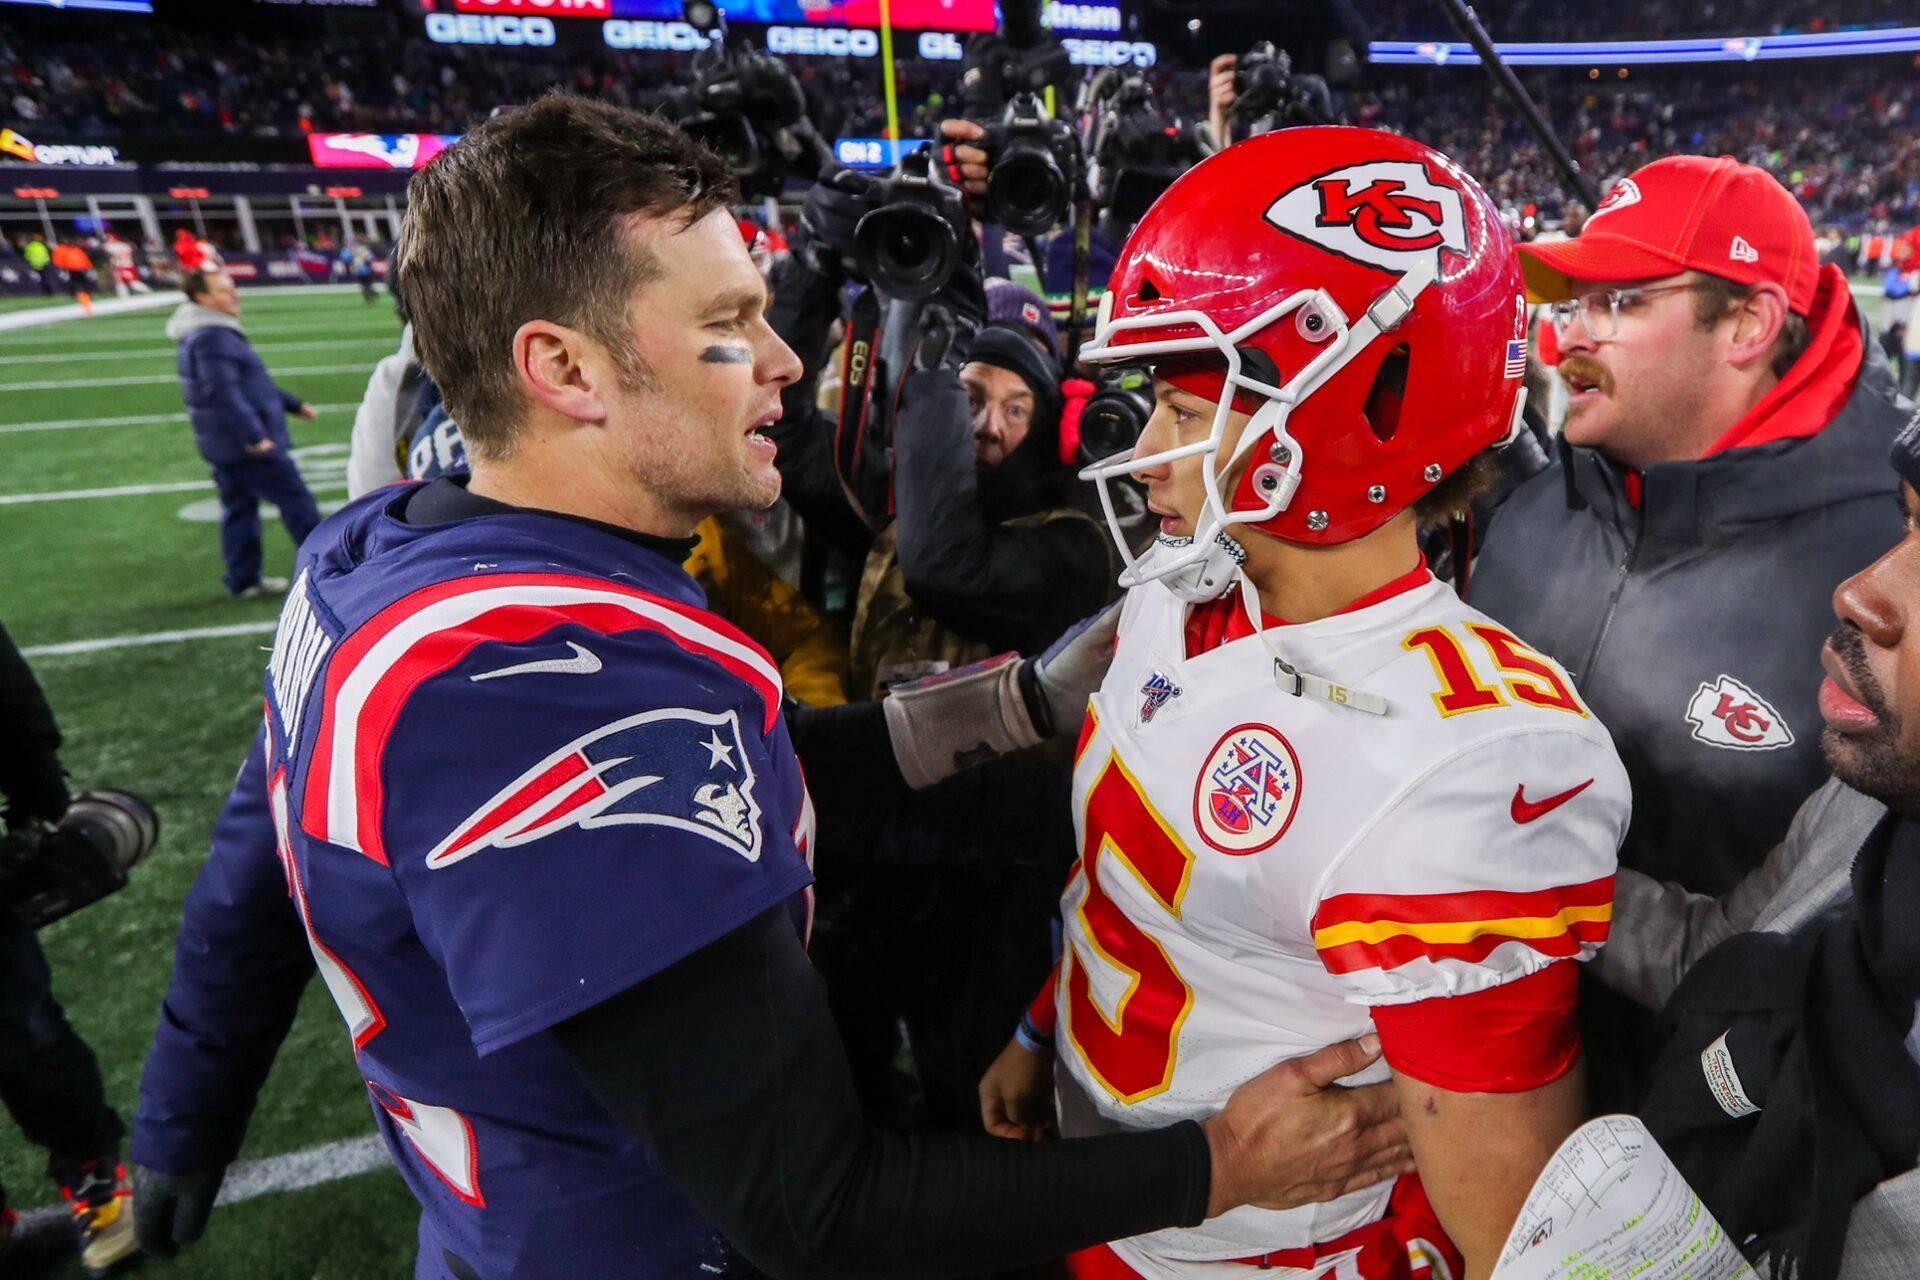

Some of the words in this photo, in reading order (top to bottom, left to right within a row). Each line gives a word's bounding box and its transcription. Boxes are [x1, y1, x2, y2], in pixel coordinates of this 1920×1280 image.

[425, 13, 556, 46] GEICO
[767, 27, 878, 57] GEICO
[1312, 179, 1445, 252] KC
[850, 340, 869, 386] EOS
[1399, 620, 1592, 719] 15
[1328, 684, 1348, 705] 15
[1711, 693, 1771, 743] KC
[1712, 1058, 1721, 1079] ITALY
[1720, 1082, 1738, 1108] DESIGN
